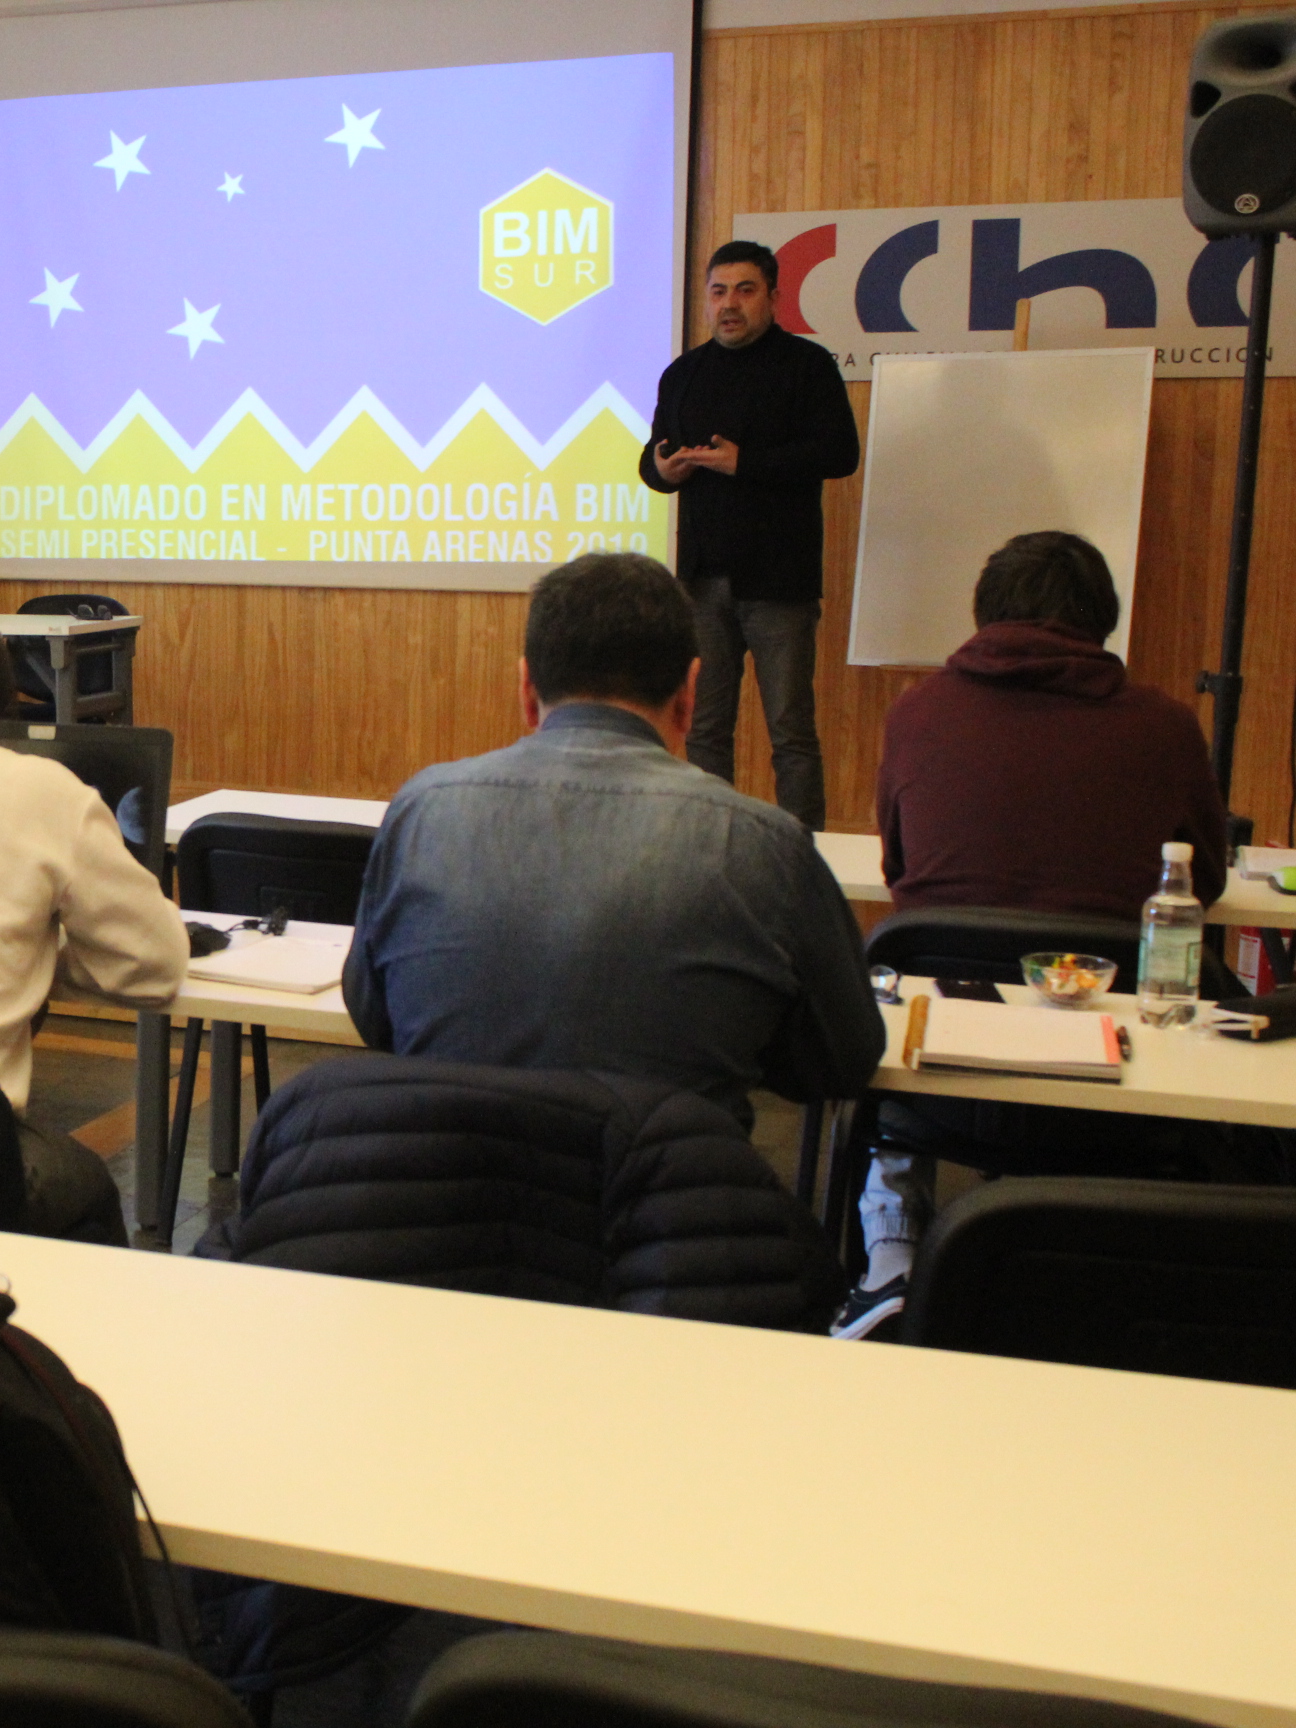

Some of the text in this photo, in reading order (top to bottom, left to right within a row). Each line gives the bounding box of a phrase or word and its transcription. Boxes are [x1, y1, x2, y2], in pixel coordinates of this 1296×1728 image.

[493, 206, 598, 258] BIM
[0, 473, 649, 522] DIPLOMADO EN METODOLOGÍA BIM
[0, 529, 70, 559] SEMI
[81, 529, 266, 561] PRESENCIAL
[309, 530, 412, 562] PUNTA
[422, 530, 553, 563] ARENAS
